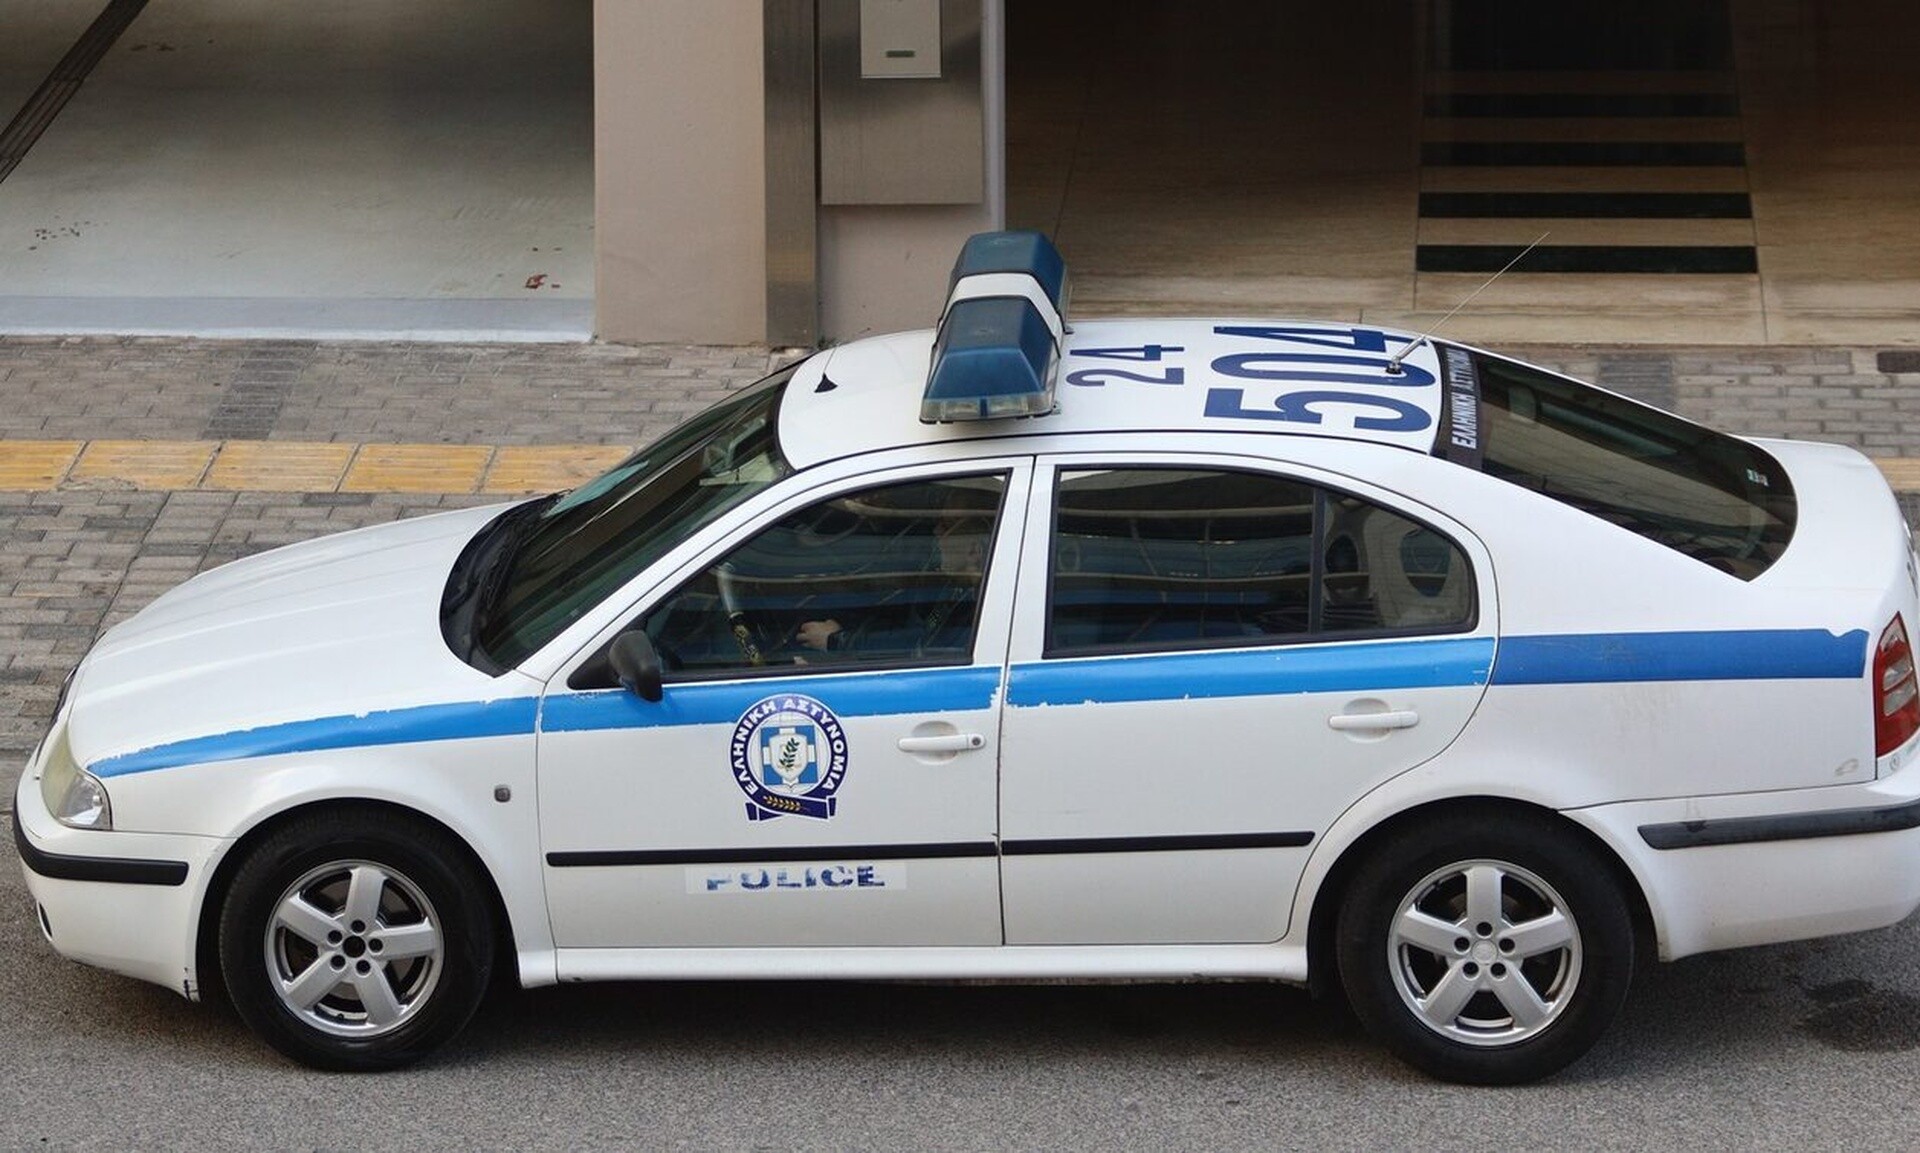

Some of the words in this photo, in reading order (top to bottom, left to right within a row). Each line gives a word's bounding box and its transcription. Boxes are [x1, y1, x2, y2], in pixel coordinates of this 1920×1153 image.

[1066, 344, 1184, 387] 24
[1203, 326, 1436, 433] 504
[1452, 391, 1476, 449] ΕΛΛΗΝΙΚΗ
[733, 699, 776, 795] ΕΛΛΗΝΙΚΗ
[782, 698, 845, 793] ΑΣΤΥΝΟΜΙΑ
